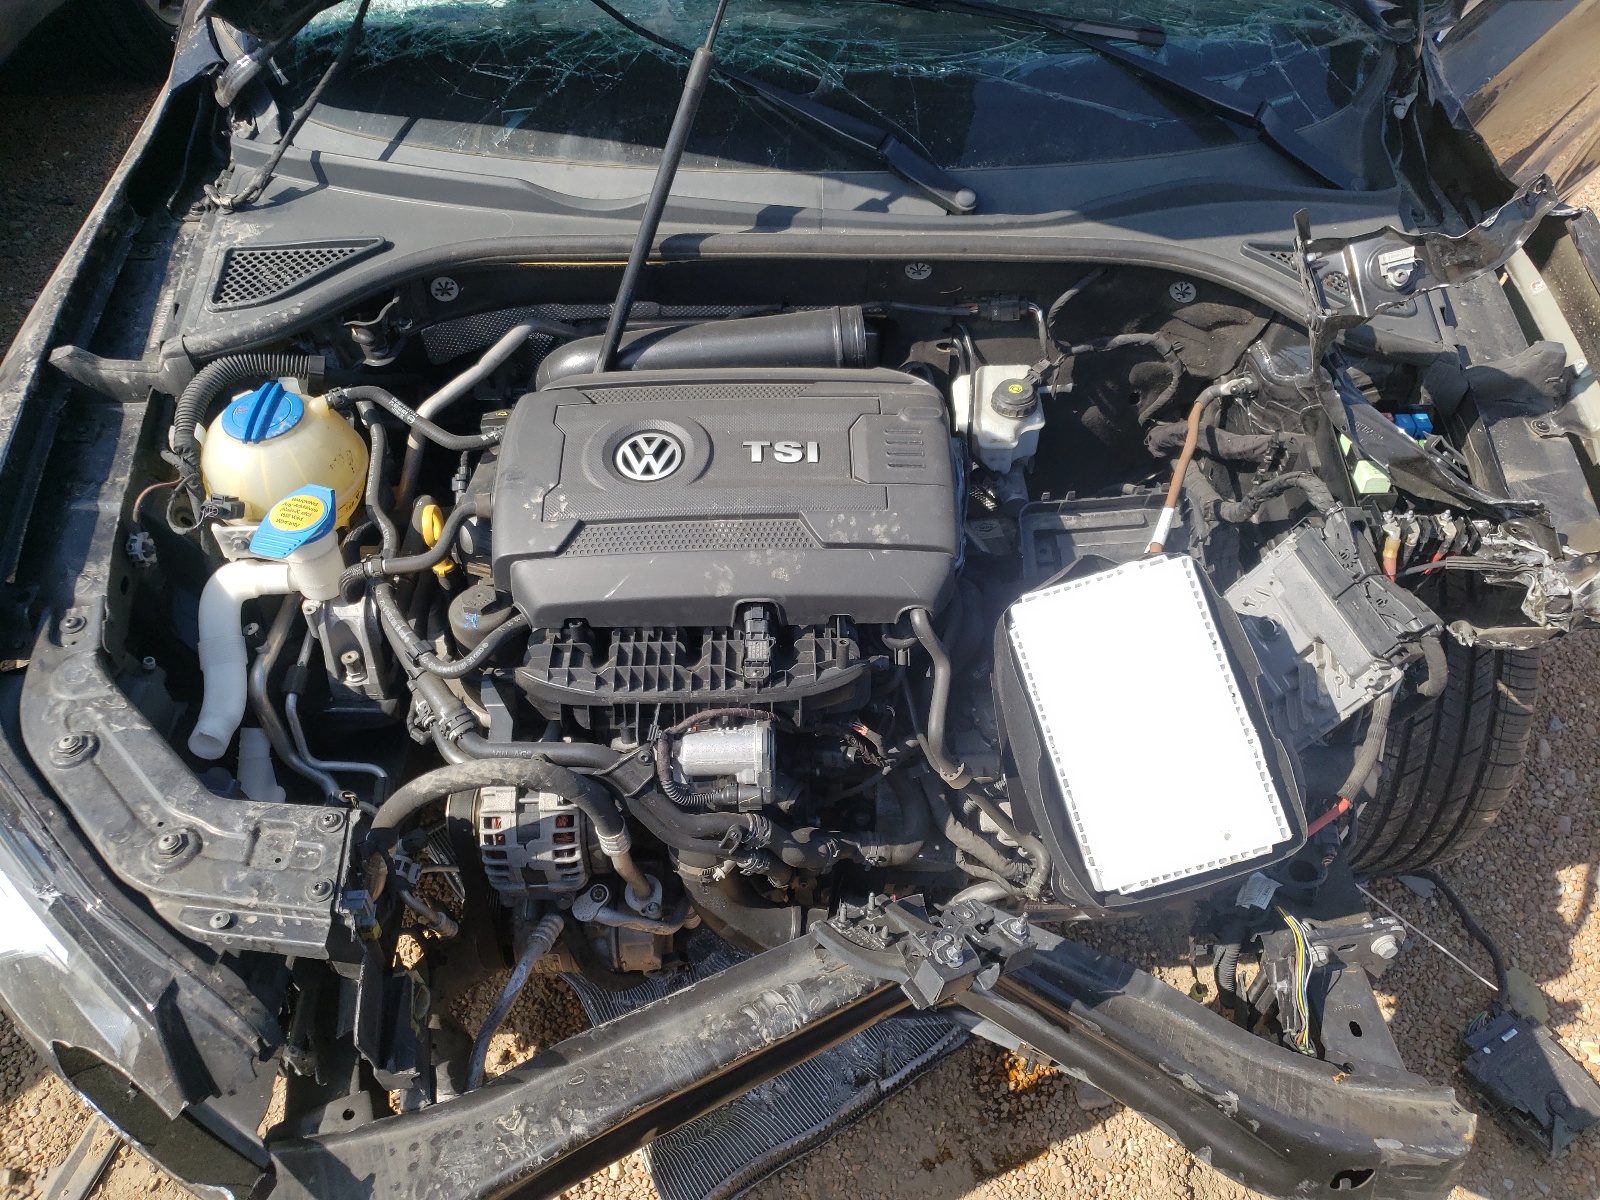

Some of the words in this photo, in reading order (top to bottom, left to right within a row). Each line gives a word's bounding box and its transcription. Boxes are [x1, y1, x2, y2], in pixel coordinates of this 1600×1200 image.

[742, 441, 820, 463] TSI
[275, 518, 301, 528] Warranty
[291, 514, 304, 522] Void
